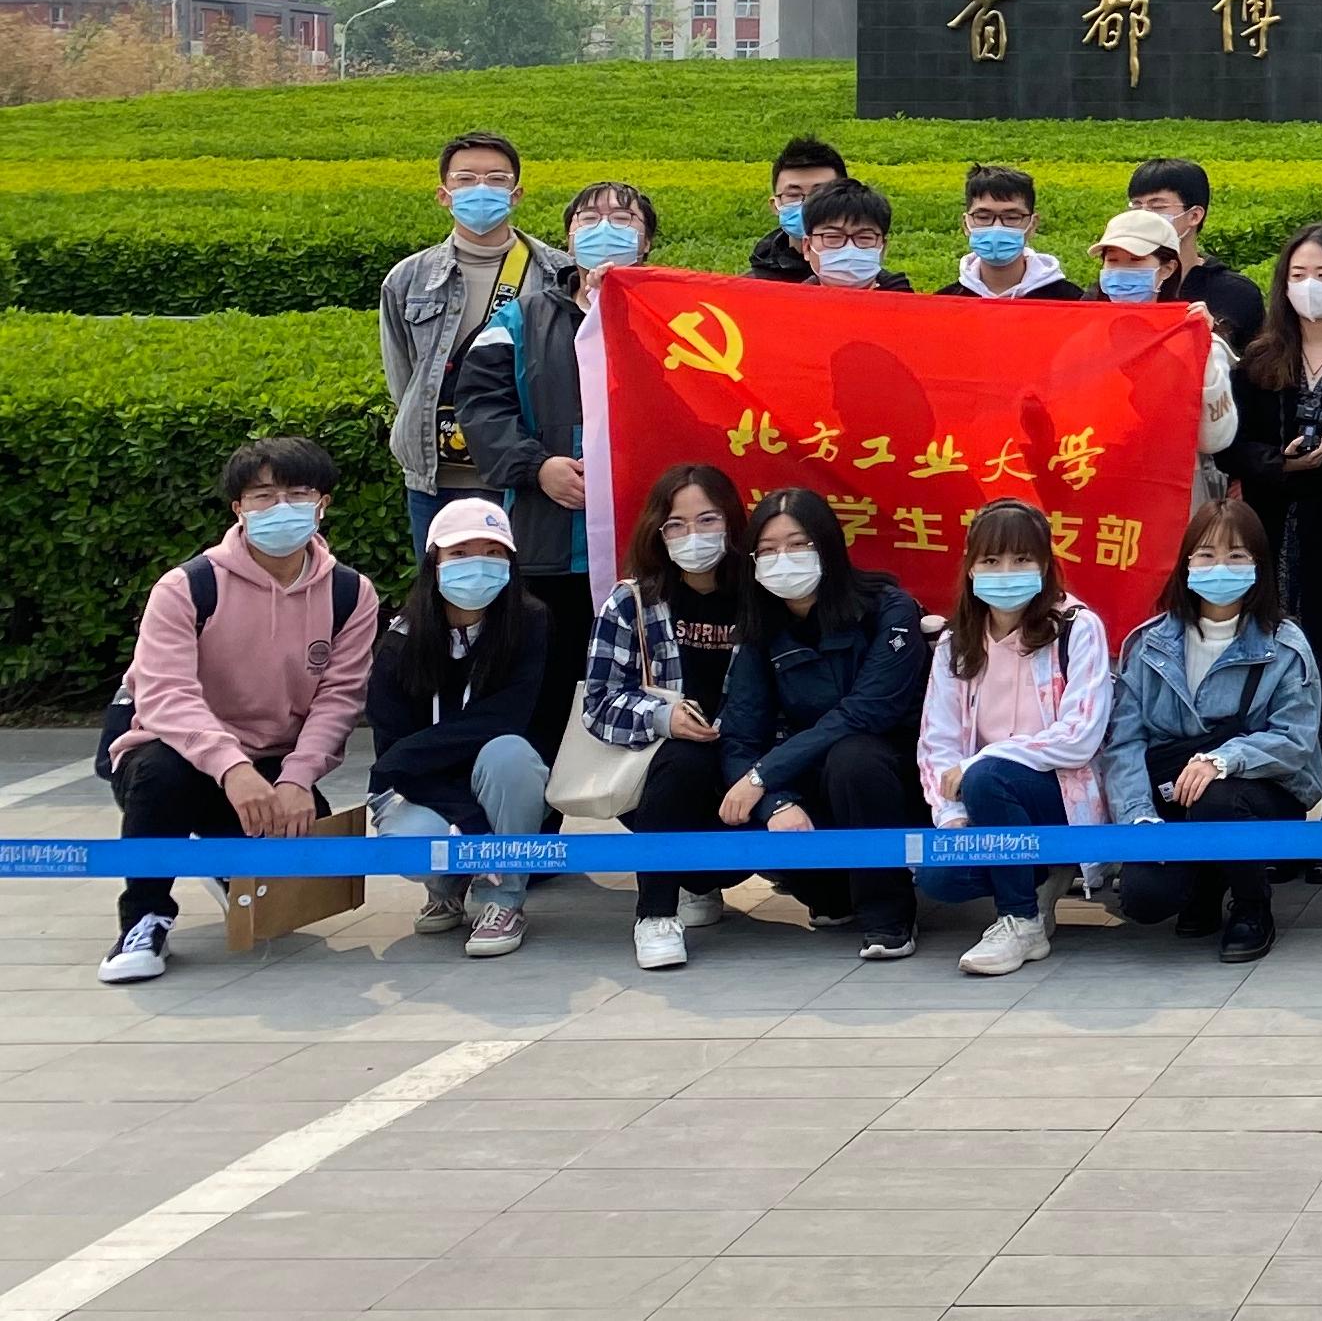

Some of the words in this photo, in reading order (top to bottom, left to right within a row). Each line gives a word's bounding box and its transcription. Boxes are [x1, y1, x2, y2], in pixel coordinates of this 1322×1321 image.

[728, 408, 1106, 491] 北方工业大学
[456, 840, 568, 860] 首都博物馆
[929, 833, 1041, 853] 首都博物馆
